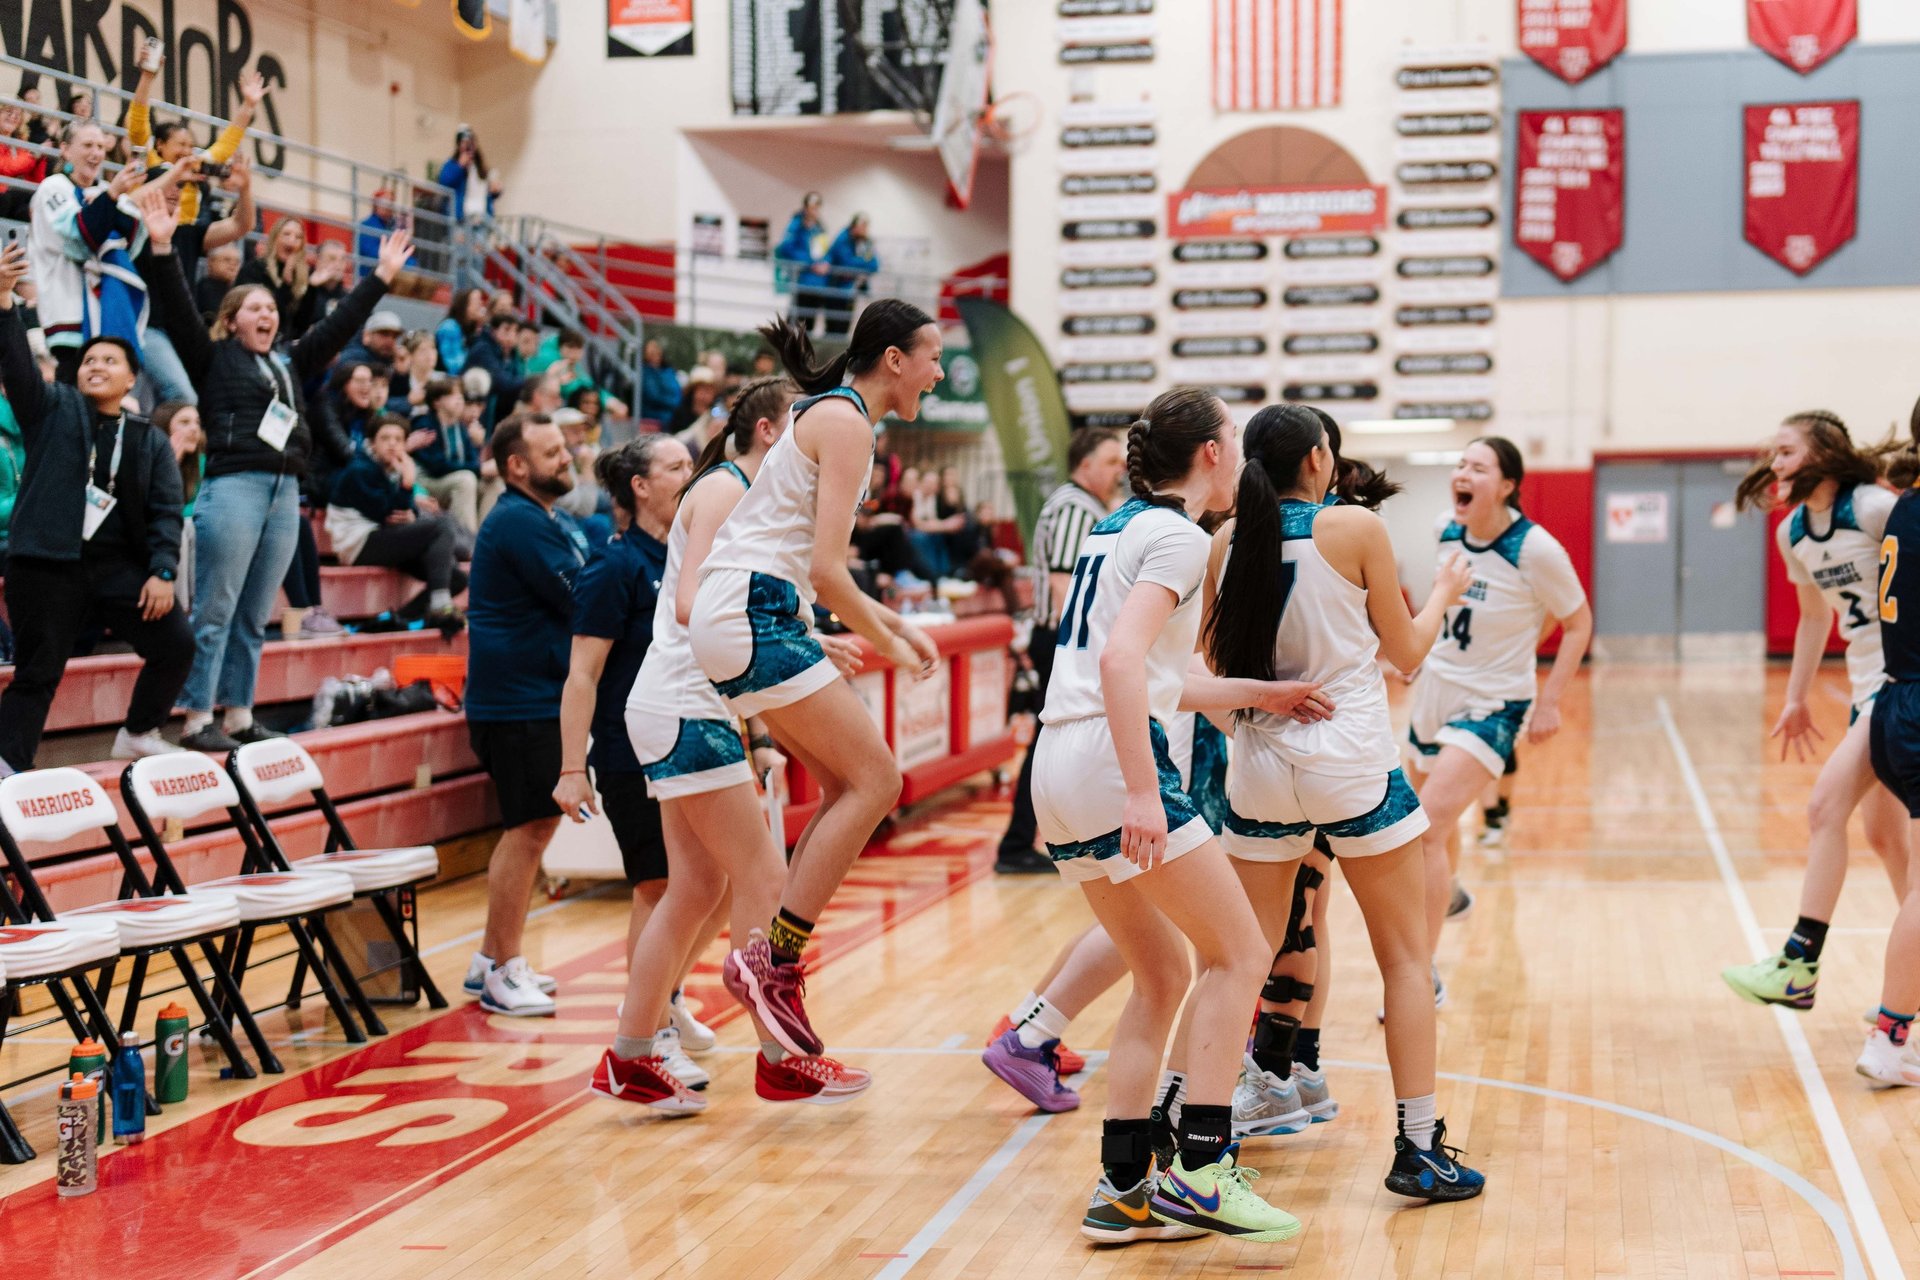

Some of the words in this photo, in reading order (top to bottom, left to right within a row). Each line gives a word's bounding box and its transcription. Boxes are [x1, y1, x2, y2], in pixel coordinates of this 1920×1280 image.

[1880, 534, 1898, 623] 2
[1055, 553, 1107, 650] 11
[1839, 590, 1871, 629] 3
[150, 771, 219, 797] WARRIORS
[252, 756, 306, 782] WARRIORS
[16, 788, 94, 818] WARRIORS
